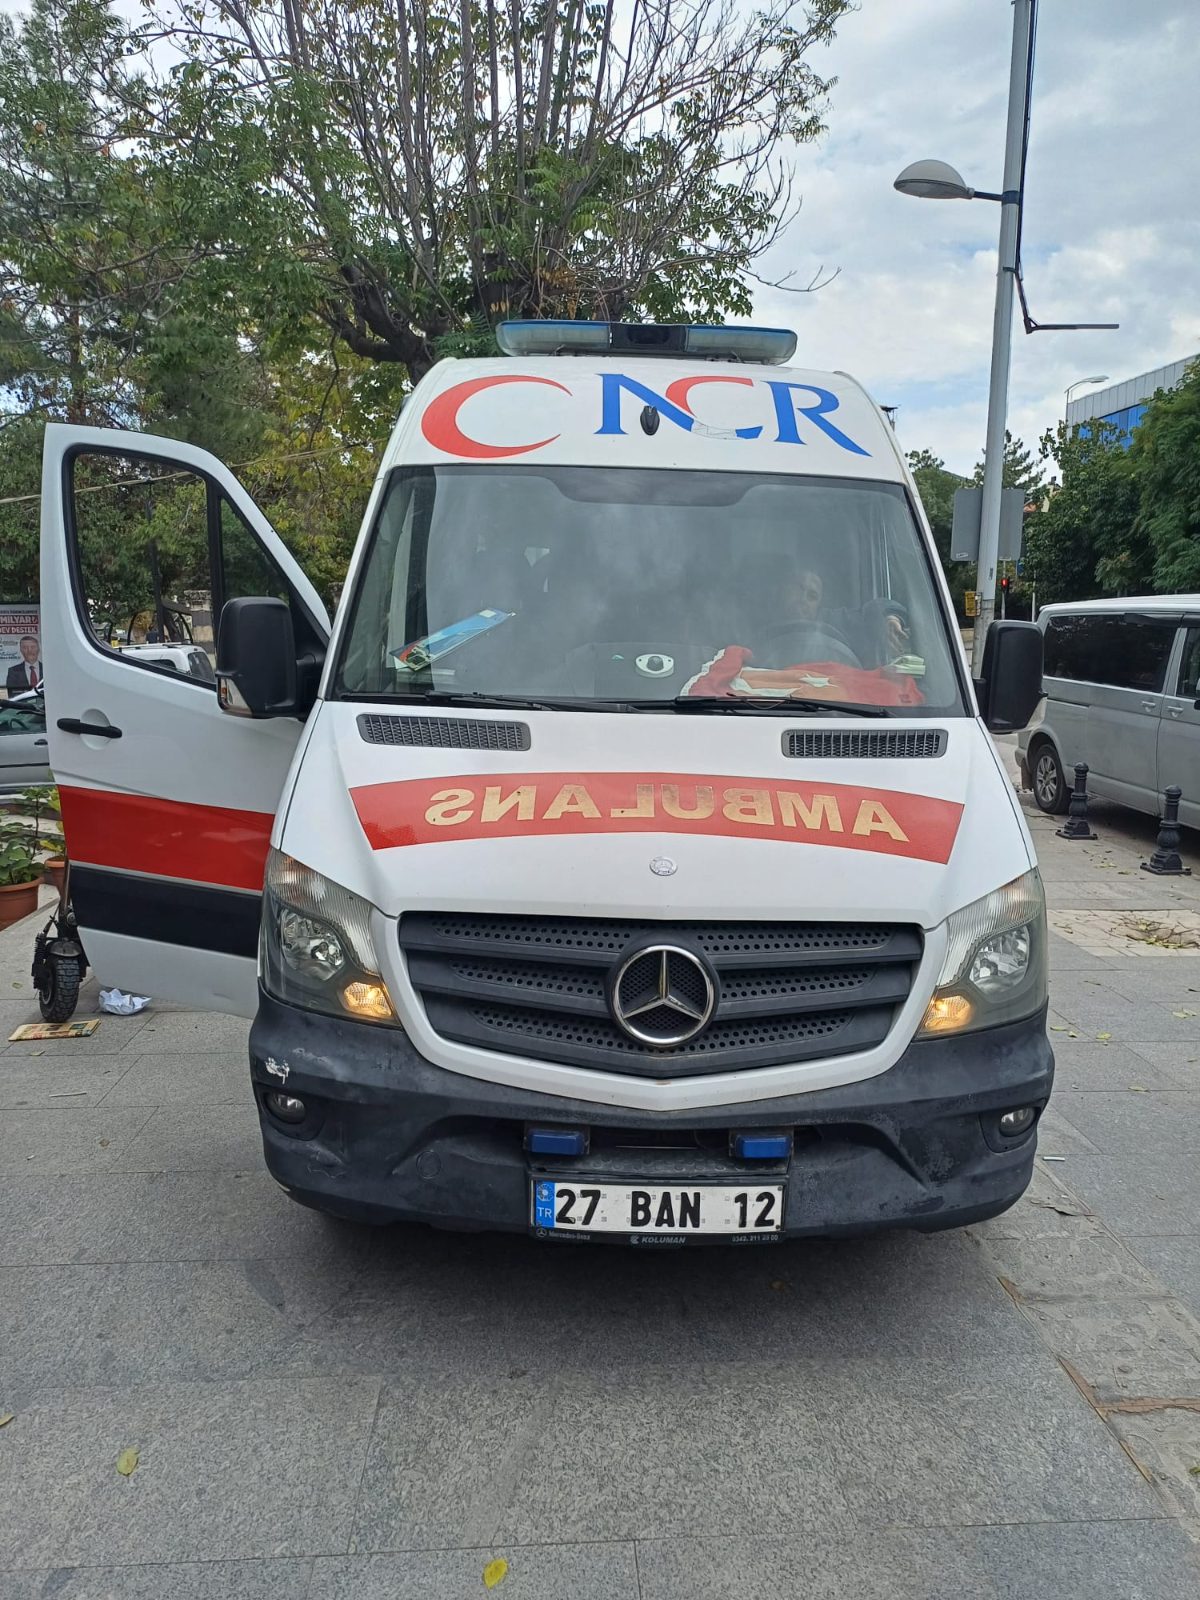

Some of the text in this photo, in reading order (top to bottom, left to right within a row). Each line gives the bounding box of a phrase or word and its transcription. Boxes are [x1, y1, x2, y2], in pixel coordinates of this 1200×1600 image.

[537, 1207, 552, 1217] TR
[555, 1189, 776, 1228] 27 BAN 12
[641, 1236, 686, 1244] KOLUMAN
